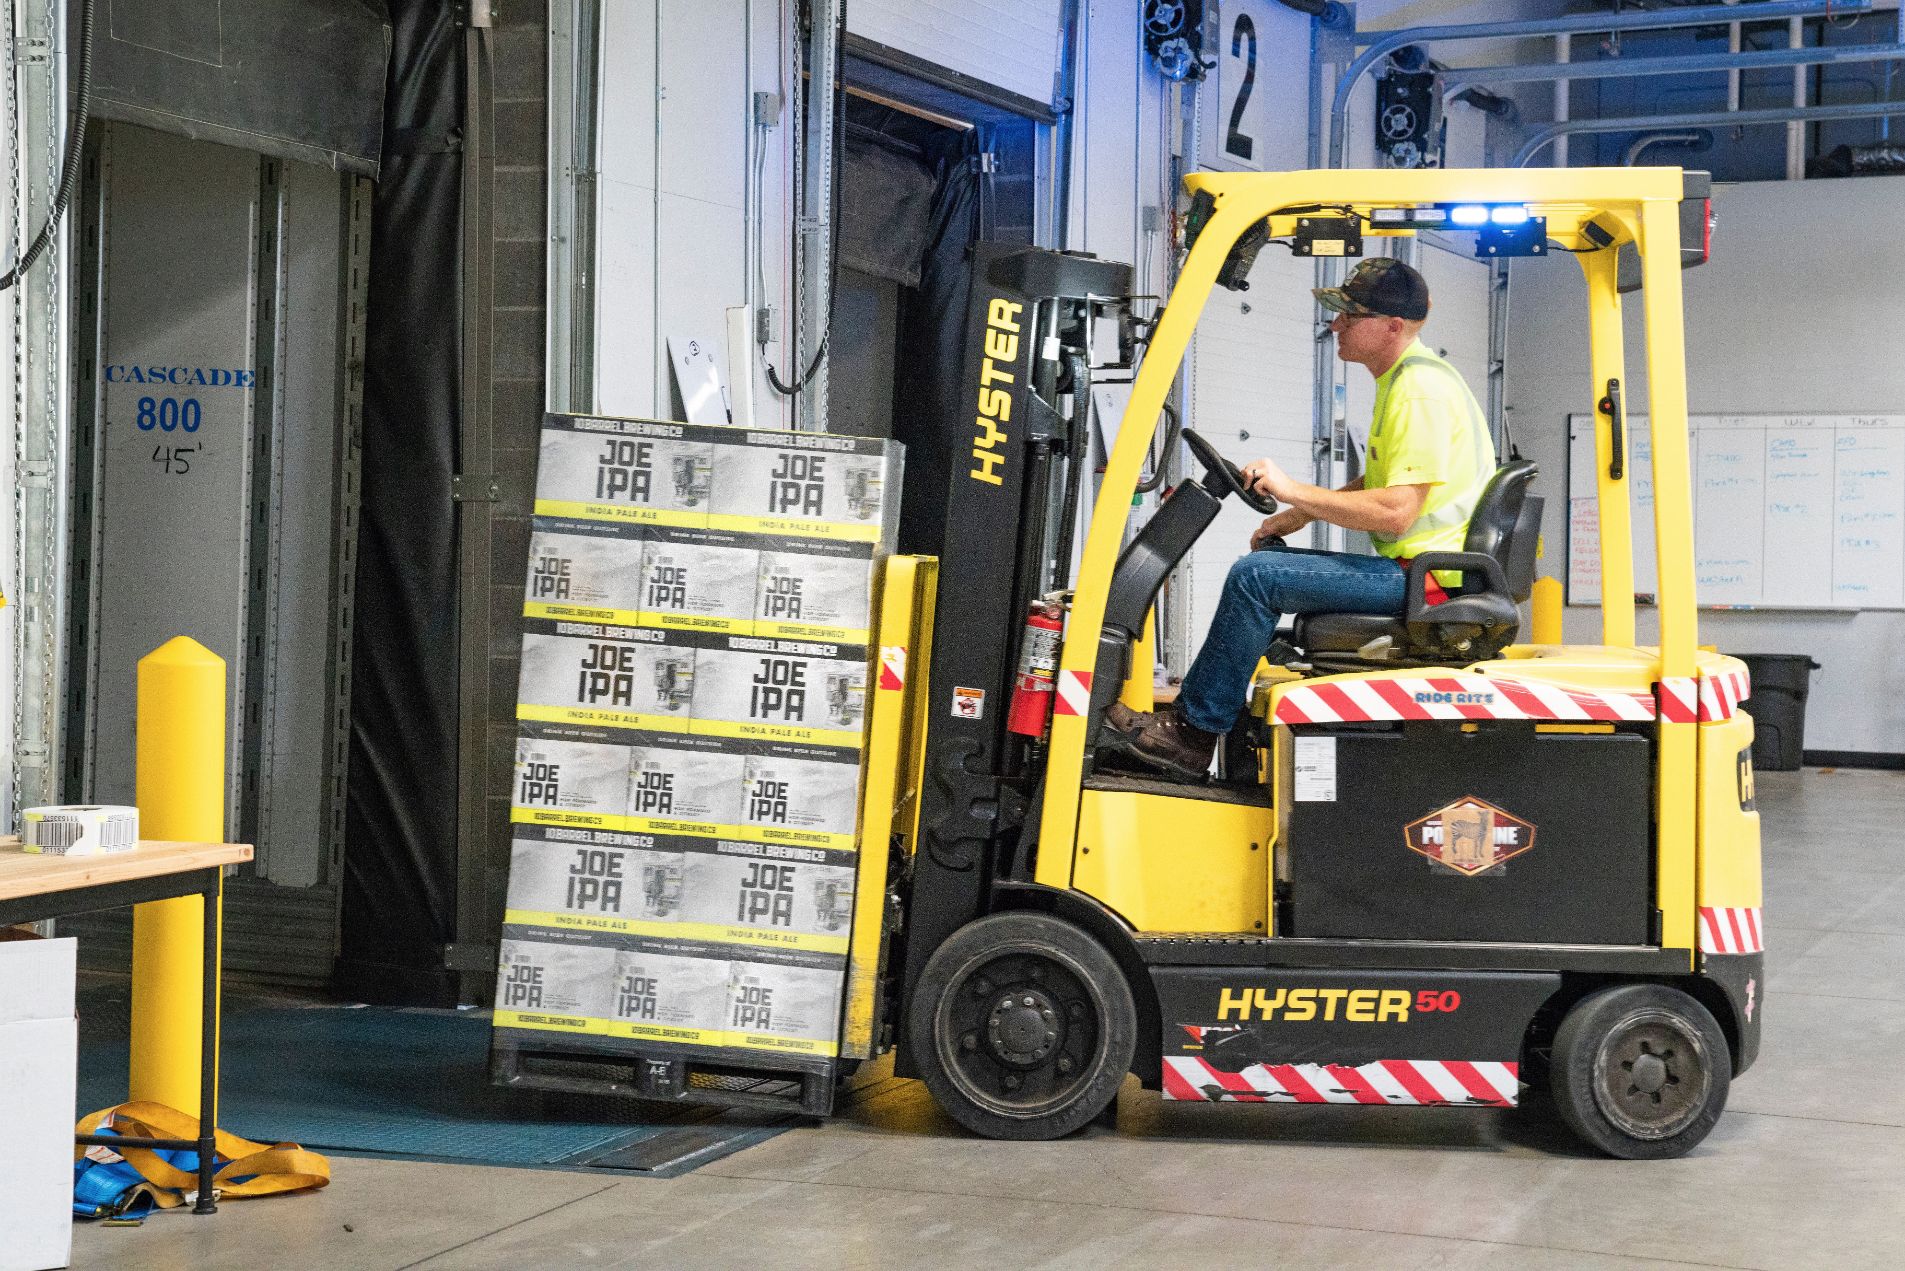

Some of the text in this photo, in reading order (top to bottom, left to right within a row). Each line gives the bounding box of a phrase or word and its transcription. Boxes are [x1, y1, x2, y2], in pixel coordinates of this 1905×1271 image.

[1225, 13, 1257, 160] 2
[106, 365, 255, 388] CASCADE
[970, 298, 1023, 486] HYSTER
[136, 396, 202, 432] 800
[600, 440, 653, 468] JOE
[772, 454, 826, 482] JOE
[596, 467, 652, 502] IPA
[769, 481, 824, 516] IPA
[586, 507, 657, 519] INDIA PALE ALE
[759, 520, 786, 529] INDIA
[790, 523, 811, 531] PALE
[535, 557, 571, 576] JOE
[650, 566, 687, 585] JOE
[533, 575, 570, 599] IPA
[648, 585, 685, 609] IPA
[766, 576, 803, 596] JOE
[764, 595, 801, 619] IPA
[581, 644, 636, 672] JOE
[753, 659, 808, 687] JOE
[578, 671, 633, 706] IPA
[1415, 692, 1452, 704] RIDE
[750, 686, 806, 721] IPA
[568, 711, 639, 723] INDIA PALE ALE
[740, 726, 811, 738] INDIA PALE ALE
[523, 763, 560, 782] JOE
[637, 772, 674, 791] JOE
[521, 782, 558, 806] IPA
[635, 790, 672, 814] IPA
[752, 780, 789, 800] JOE
[750, 799, 787, 823] IPA
[569, 849, 624, 878] JOE
[741, 862, 796, 892] JOE
[566, 877, 622, 912] IPA
[738, 890, 792, 926] IPA
[556, 917, 628, 929] INDIA PALE ALE
[727, 930, 798, 943] INDIA PALE ALE
[507, 964, 543, 984] JOE
[620, 976, 657, 996] JOE
[504, 983, 542, 1008] IPA
[618, 995, 656, 1019] IPA
[736, 986, 773, 1006] JOE
[1216, 987, 1461, 1023] HYSTER 50
[733, 1005, 771, 1029] IPA
